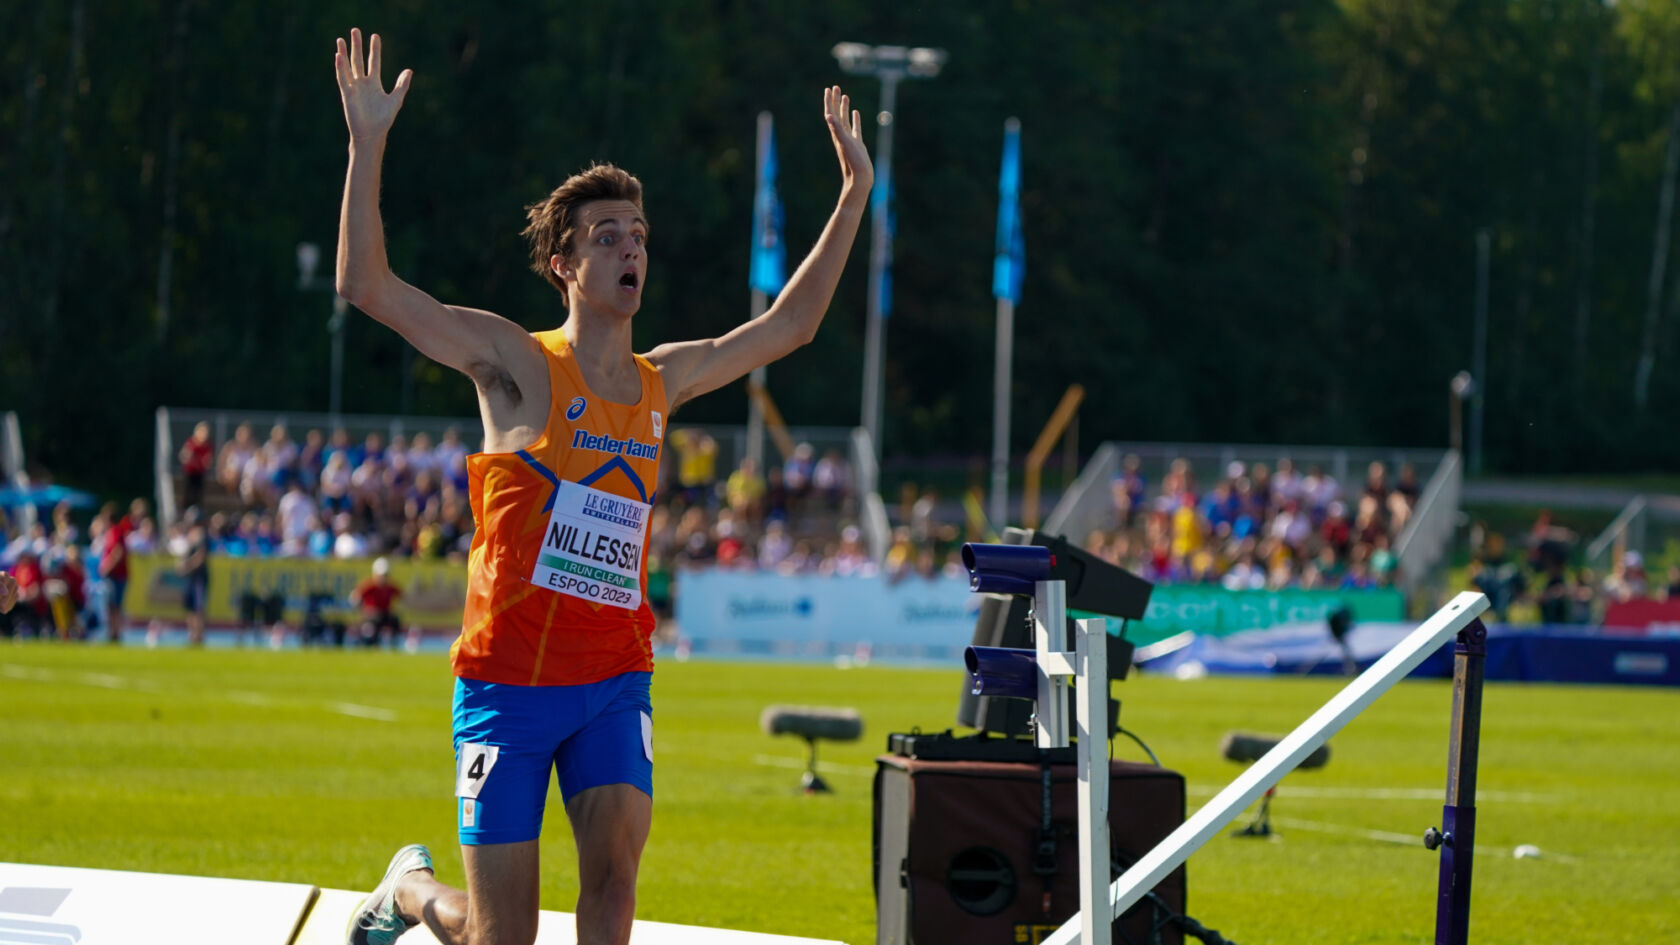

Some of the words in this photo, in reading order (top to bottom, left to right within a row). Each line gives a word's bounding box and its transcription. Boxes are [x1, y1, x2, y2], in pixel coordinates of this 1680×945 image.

[585, 493, 600, 510] LE
[546, 521, 640, 572] NILLESSEN
[548, 572, 600, 597] ESPOO
[601, 587, 632, 604] 2023
[563, 561, 569, 570] I
[569, 562, 593, 577] RUN
[594, 569, 627, 586] CLEAN
[467, 752, 486, 782] 4
